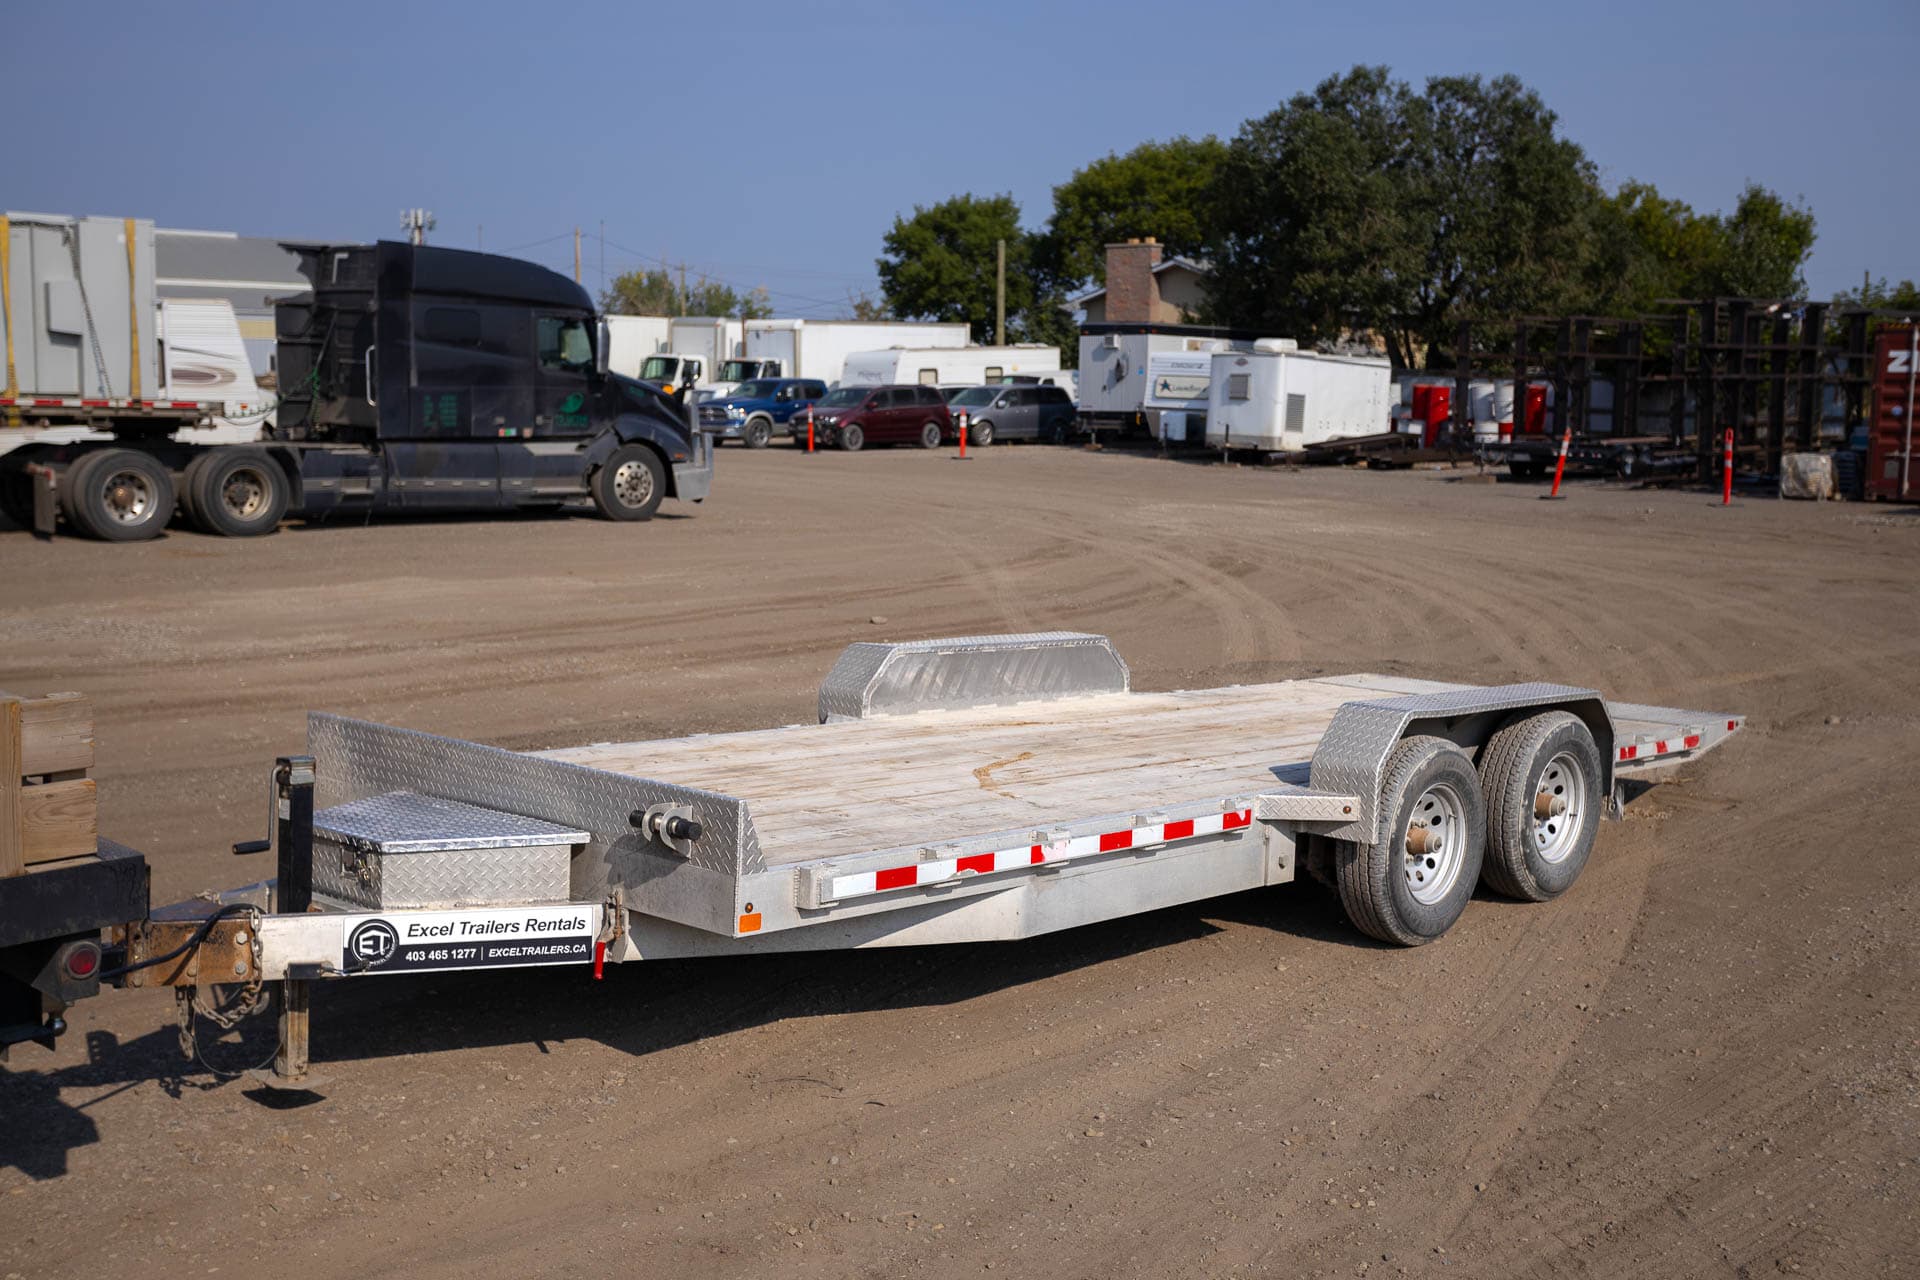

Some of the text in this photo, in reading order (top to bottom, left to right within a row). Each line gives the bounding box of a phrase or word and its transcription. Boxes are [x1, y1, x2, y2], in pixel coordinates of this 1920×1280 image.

[407, 916, 587, 938] Excel Trailers Rentals
[405, 950, 426, 962] 403
[428, 949, 449, 961] 465
[451, 948, 477, 960] 1277
[488, 944, 587, 958] EXCELTRAILERS.CA
